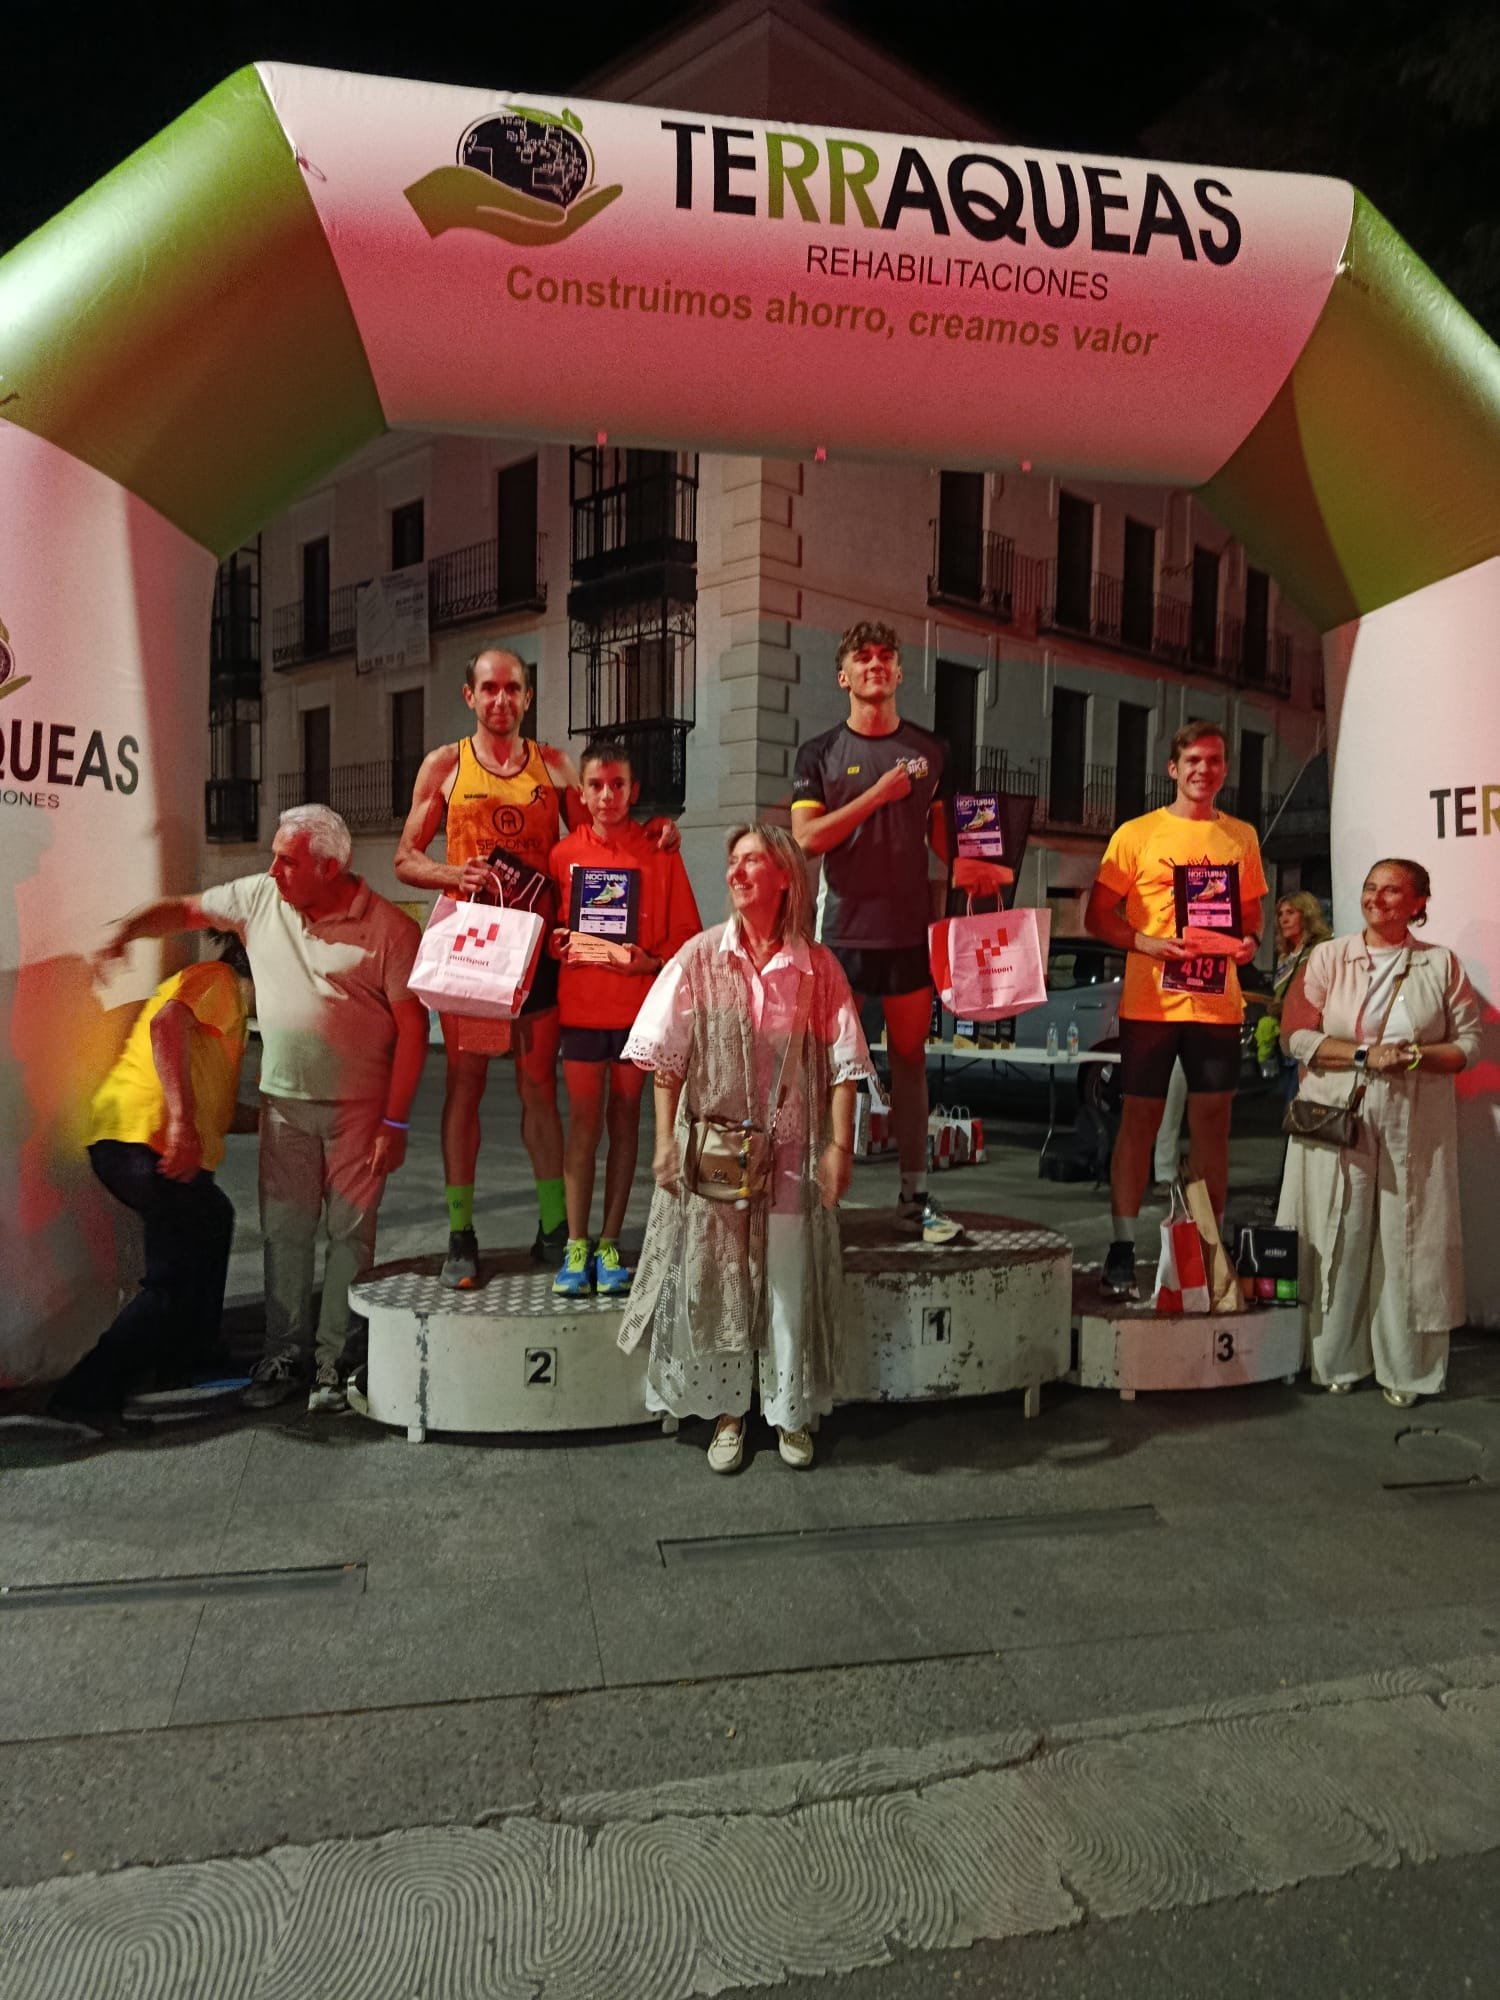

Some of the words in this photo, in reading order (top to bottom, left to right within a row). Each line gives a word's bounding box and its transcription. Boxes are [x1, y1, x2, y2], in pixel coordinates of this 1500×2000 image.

[661, 119, 1241, 266] TERRAQUEAS
[806, 244, 1109, 301] REHABILITACIONES
[506, 264, 752, 321] Construimos
[765, 290, 895, 339] ahorro,
[908, 309, 1060, 348] creamos
[1072, 321, 1159, 357] valor
[0, 719, 140, 796] UEAS
[585, 873, 628, 882] NOCTURNA
[1187, 870, 1227, 878] NOCTURNA
[1181, 957, 1215, 979] 413
[928, 1310, 946, 1342] 1
[1217, 1332, 1234, 1362] 3
[528, 1350, 552, 1384] 2
